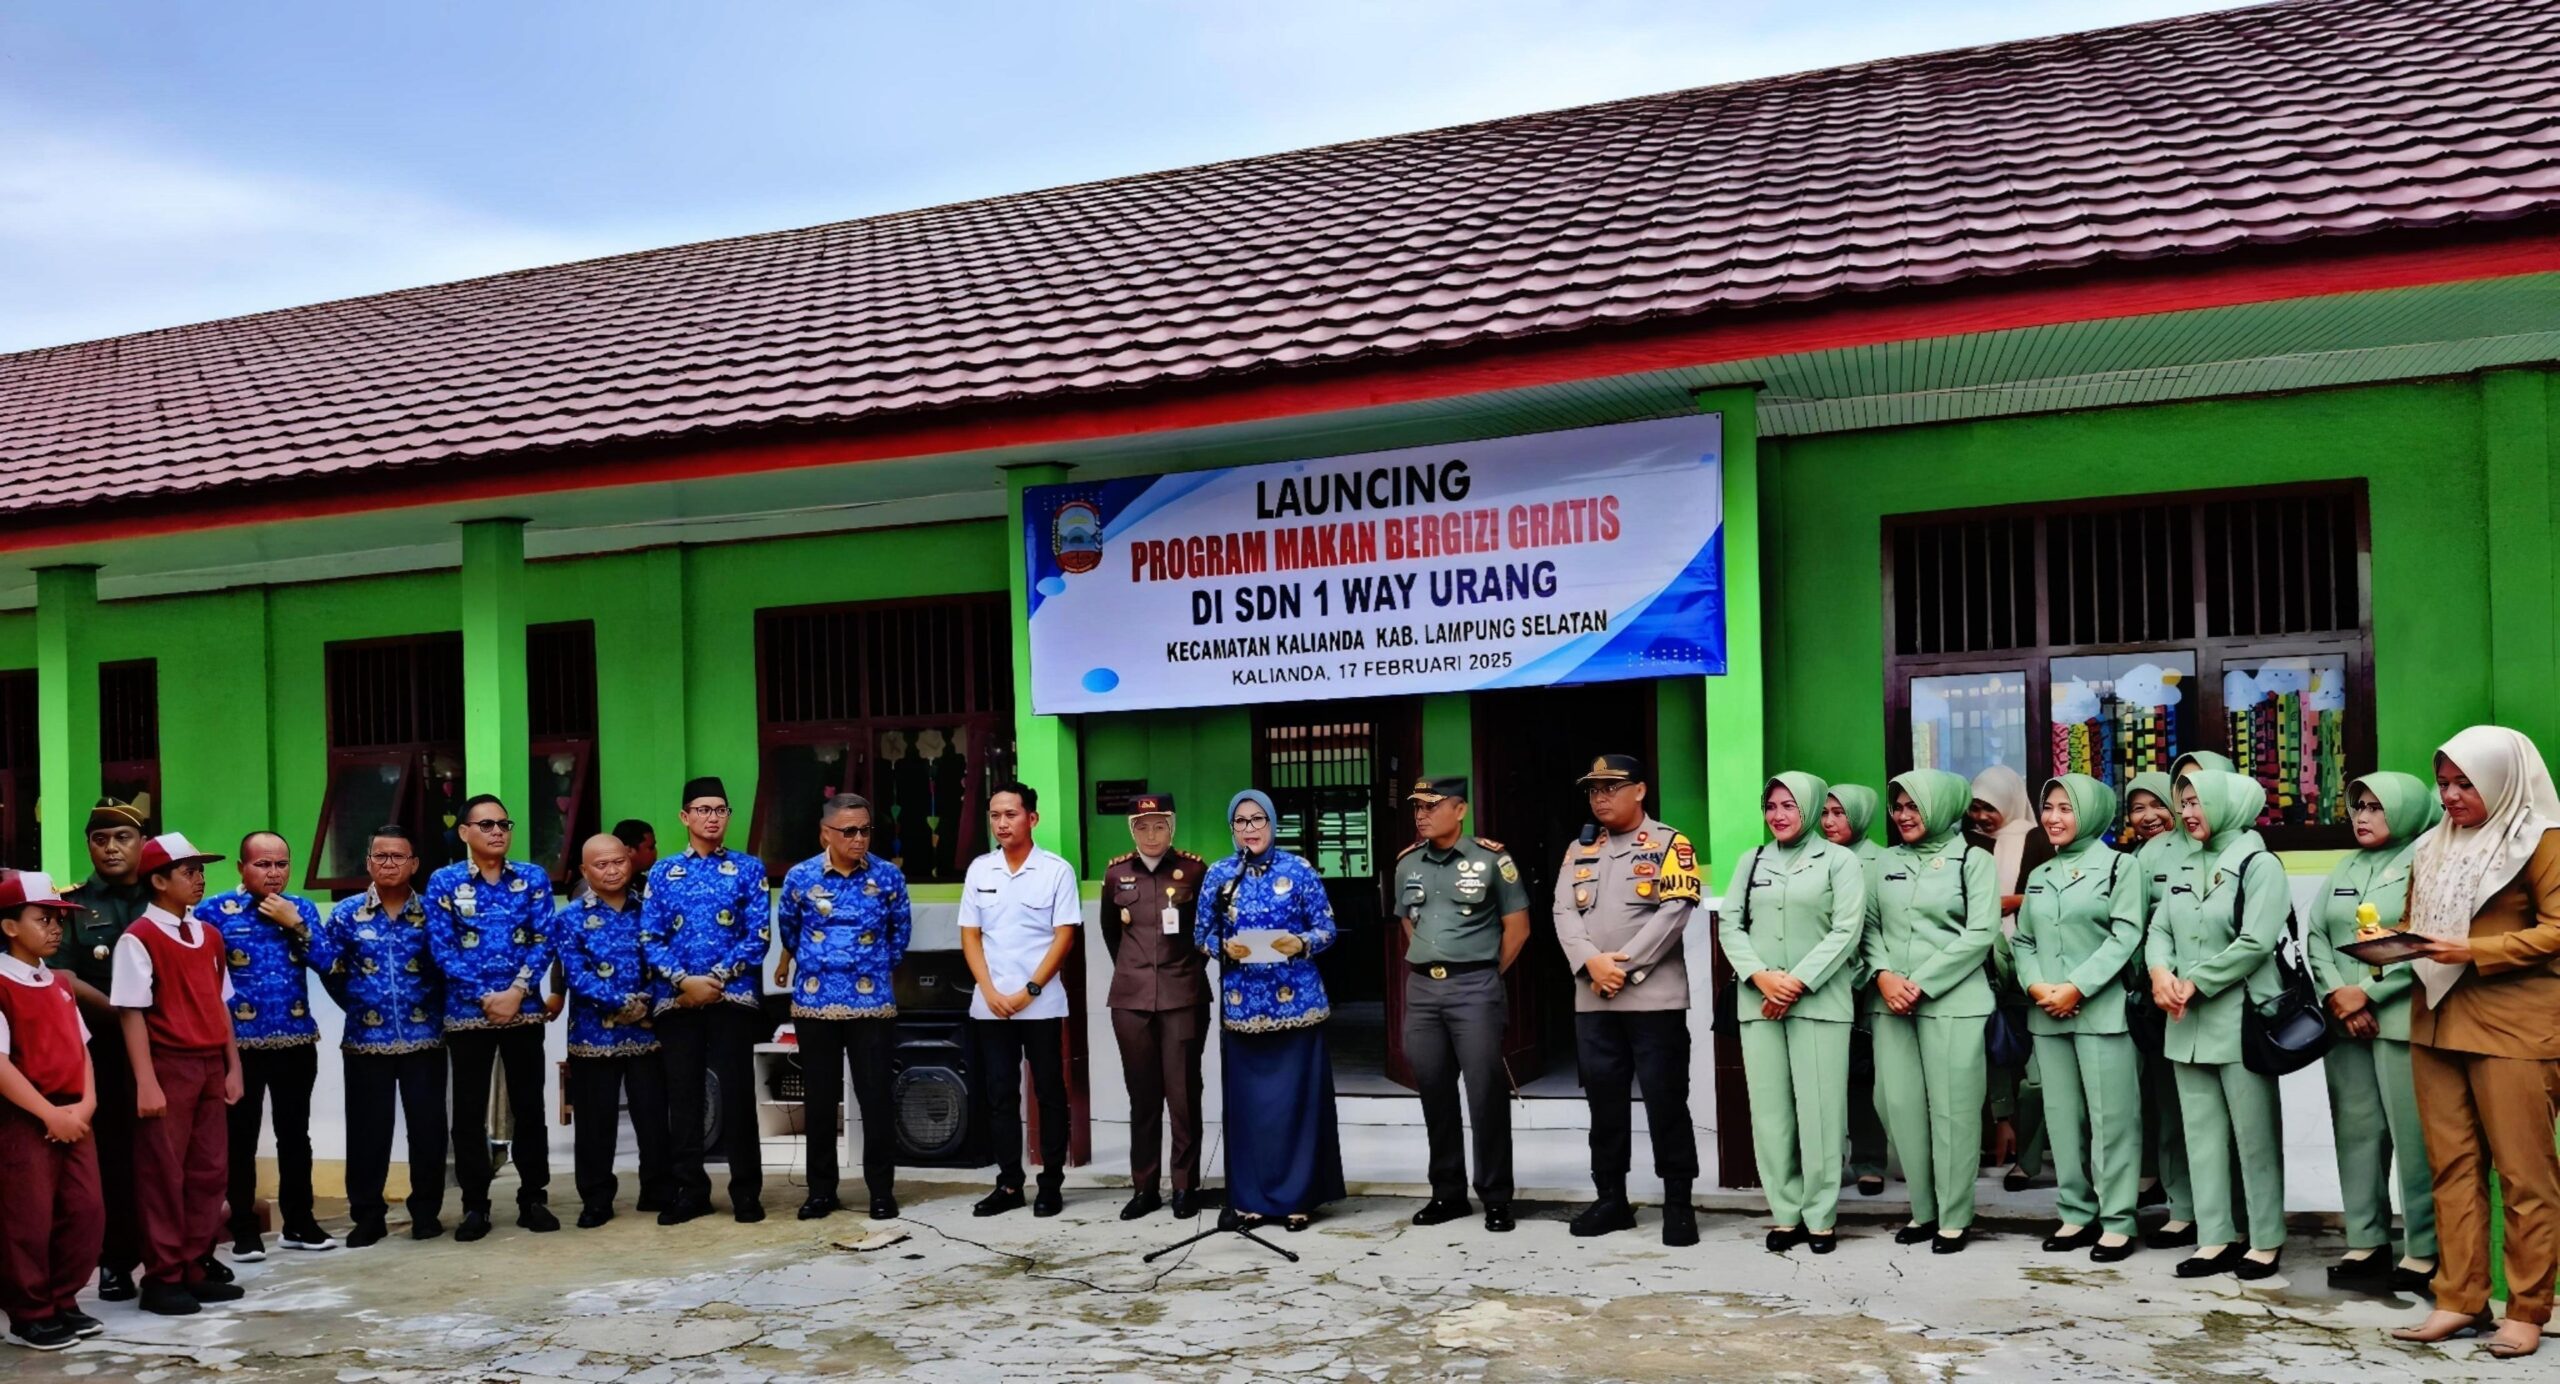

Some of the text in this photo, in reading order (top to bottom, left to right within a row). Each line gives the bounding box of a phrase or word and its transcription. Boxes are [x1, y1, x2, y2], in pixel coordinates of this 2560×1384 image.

[1256, 459, 1471, 520] LAUNCING
[1130, 495, 1620, 583] PROGRAM MAKAN BERGIZI GRATIS
[1192, 560, 1558, 625] DI SDN 1 WAY URANG
[1166, 609, 1608, 662] KECAMATAN KALIANDA KAB. LAMPUNG SELATAN
[1339, 662, 1357, 679] 17
[1364, 655, 1462, 677] FEBRUARI
[1469, 651, 1512, 671] 2025
